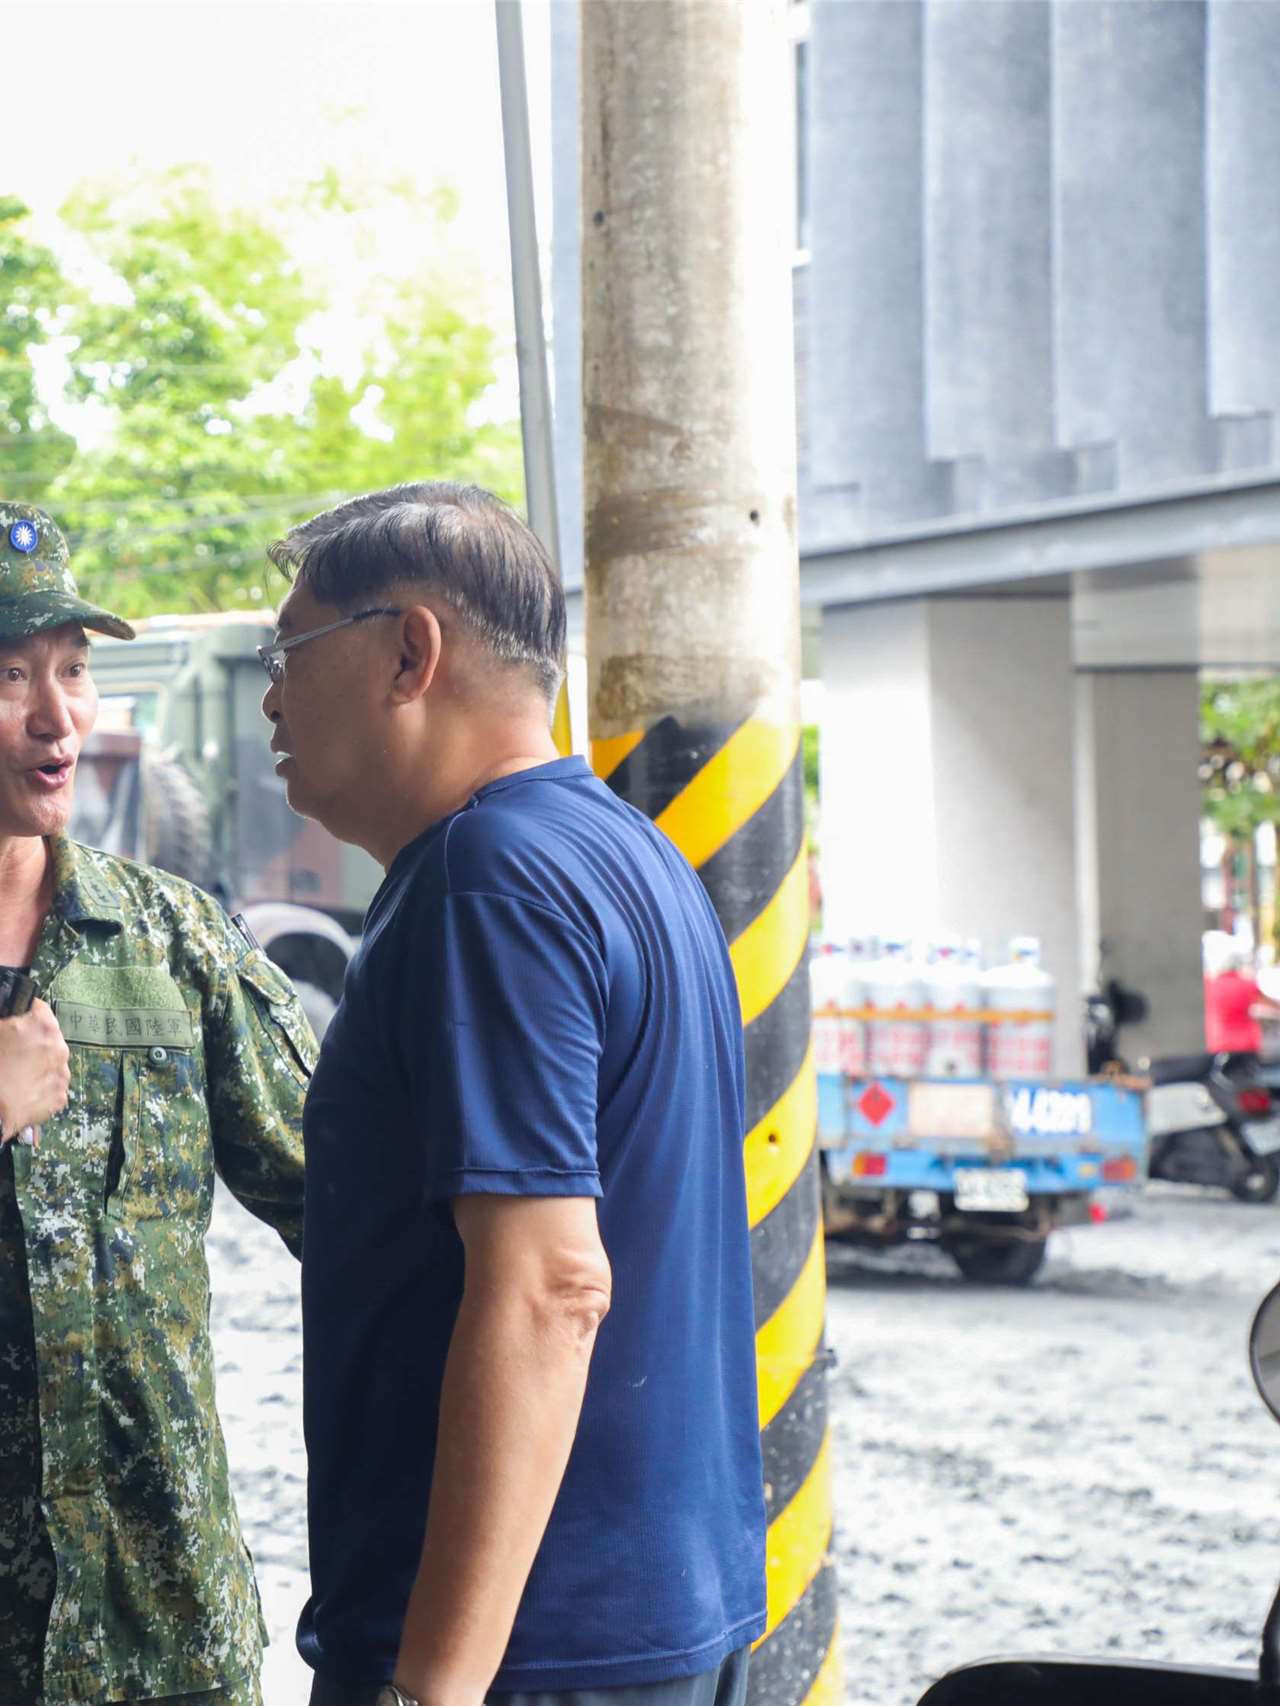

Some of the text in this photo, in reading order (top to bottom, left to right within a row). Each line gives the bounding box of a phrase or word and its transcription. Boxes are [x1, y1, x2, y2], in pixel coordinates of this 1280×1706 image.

[70, 1010, 182, 1037] 中華民國陸軍
